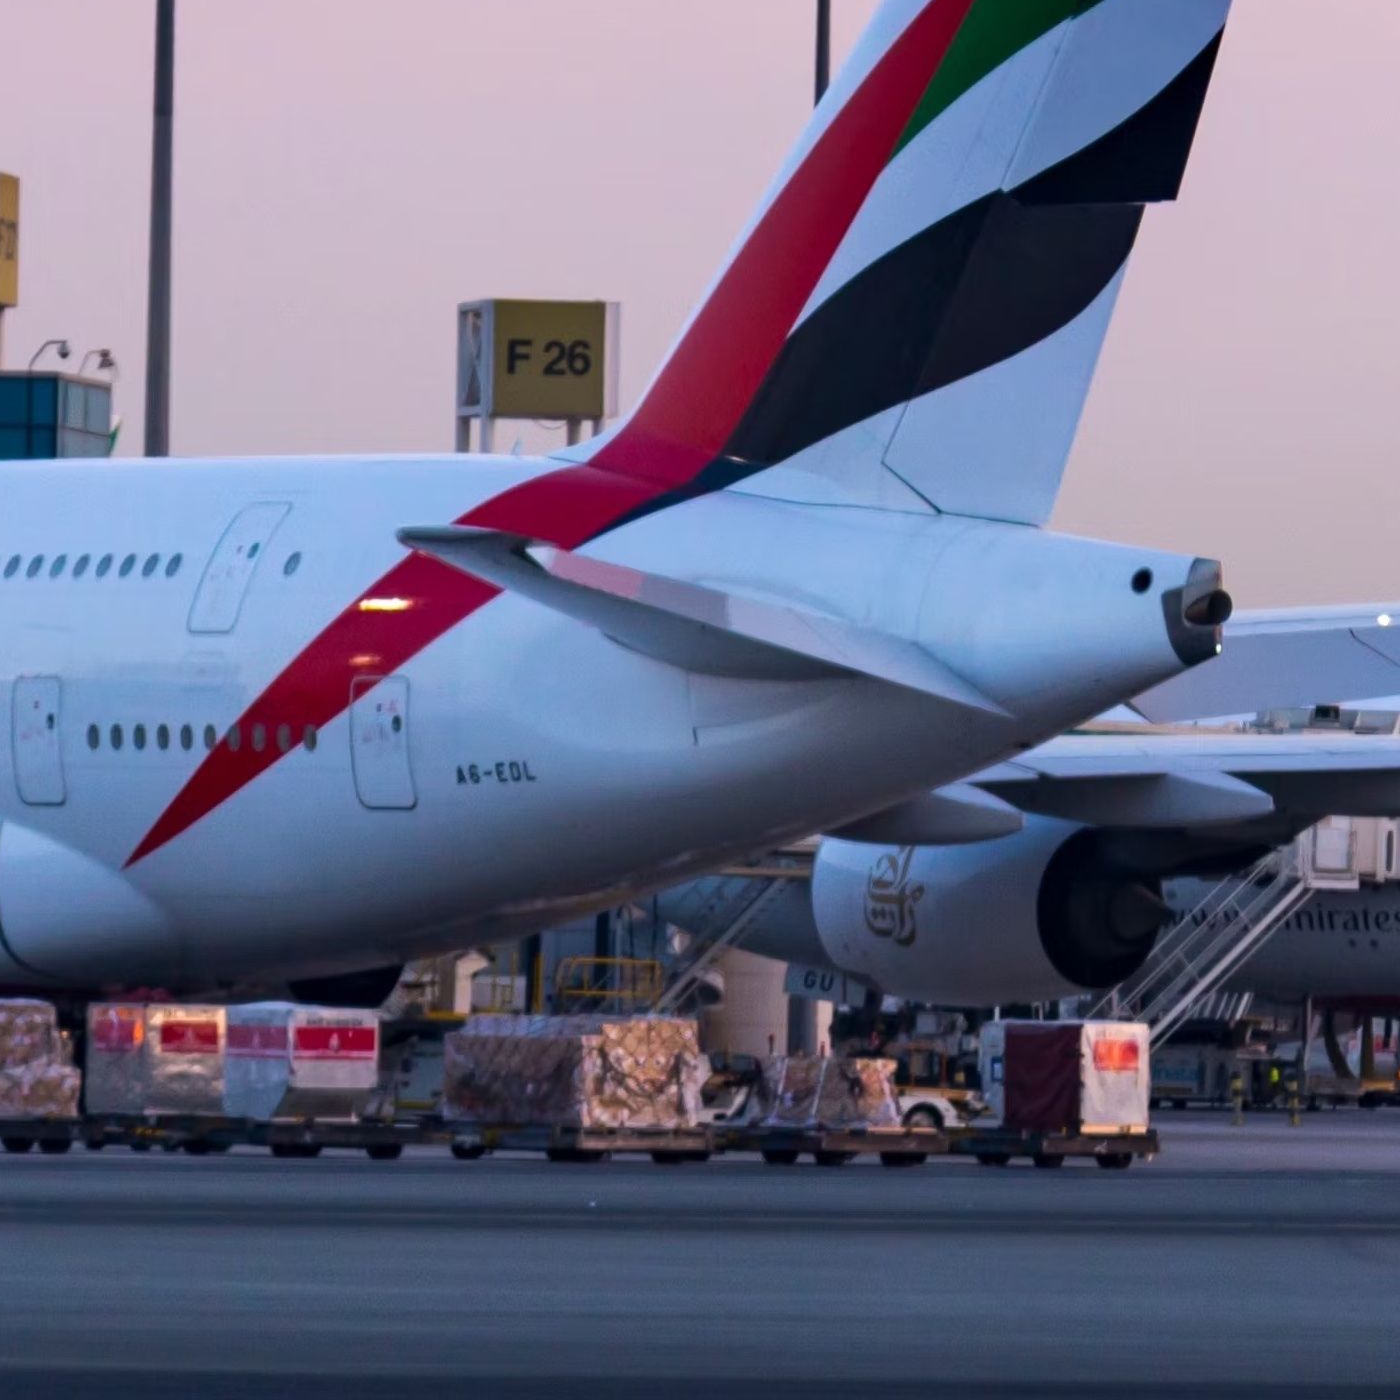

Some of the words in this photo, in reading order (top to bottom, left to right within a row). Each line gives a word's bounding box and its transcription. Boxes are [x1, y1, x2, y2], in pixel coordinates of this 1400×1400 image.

[506, 338, 533, 376] F
[543, 339, 592, 377] 26
[803, 969, 834, 993] GU
